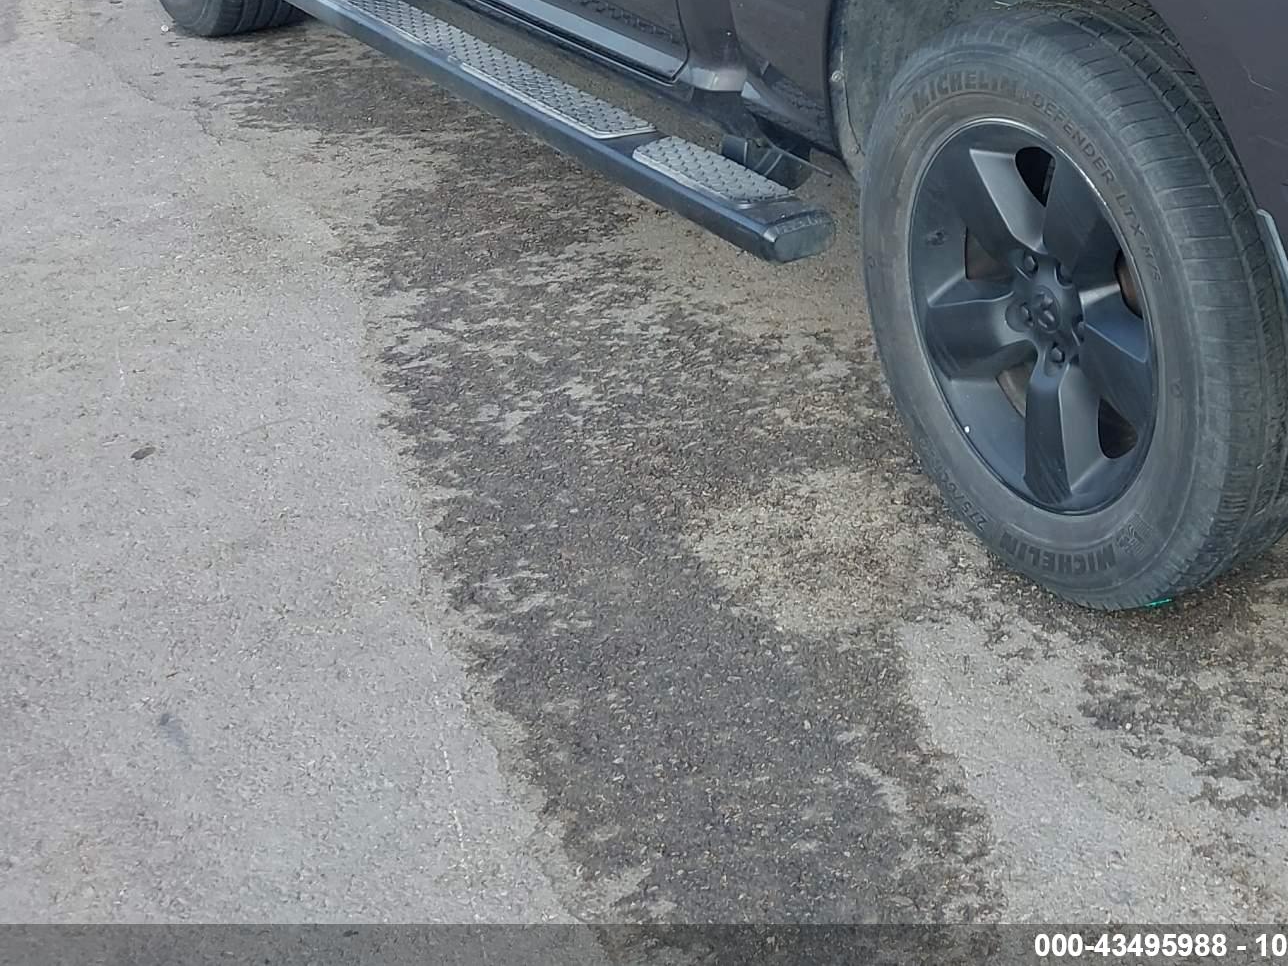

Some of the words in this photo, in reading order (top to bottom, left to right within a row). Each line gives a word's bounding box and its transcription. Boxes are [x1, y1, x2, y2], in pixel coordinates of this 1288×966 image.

[911, 69, 1019, 115] MICHELIN
[1032, 93, 1116, 185] DEFENDER
[1116, 194, 1145, 237] LTX
[999, 532, 1117, 576] MICHELIN
